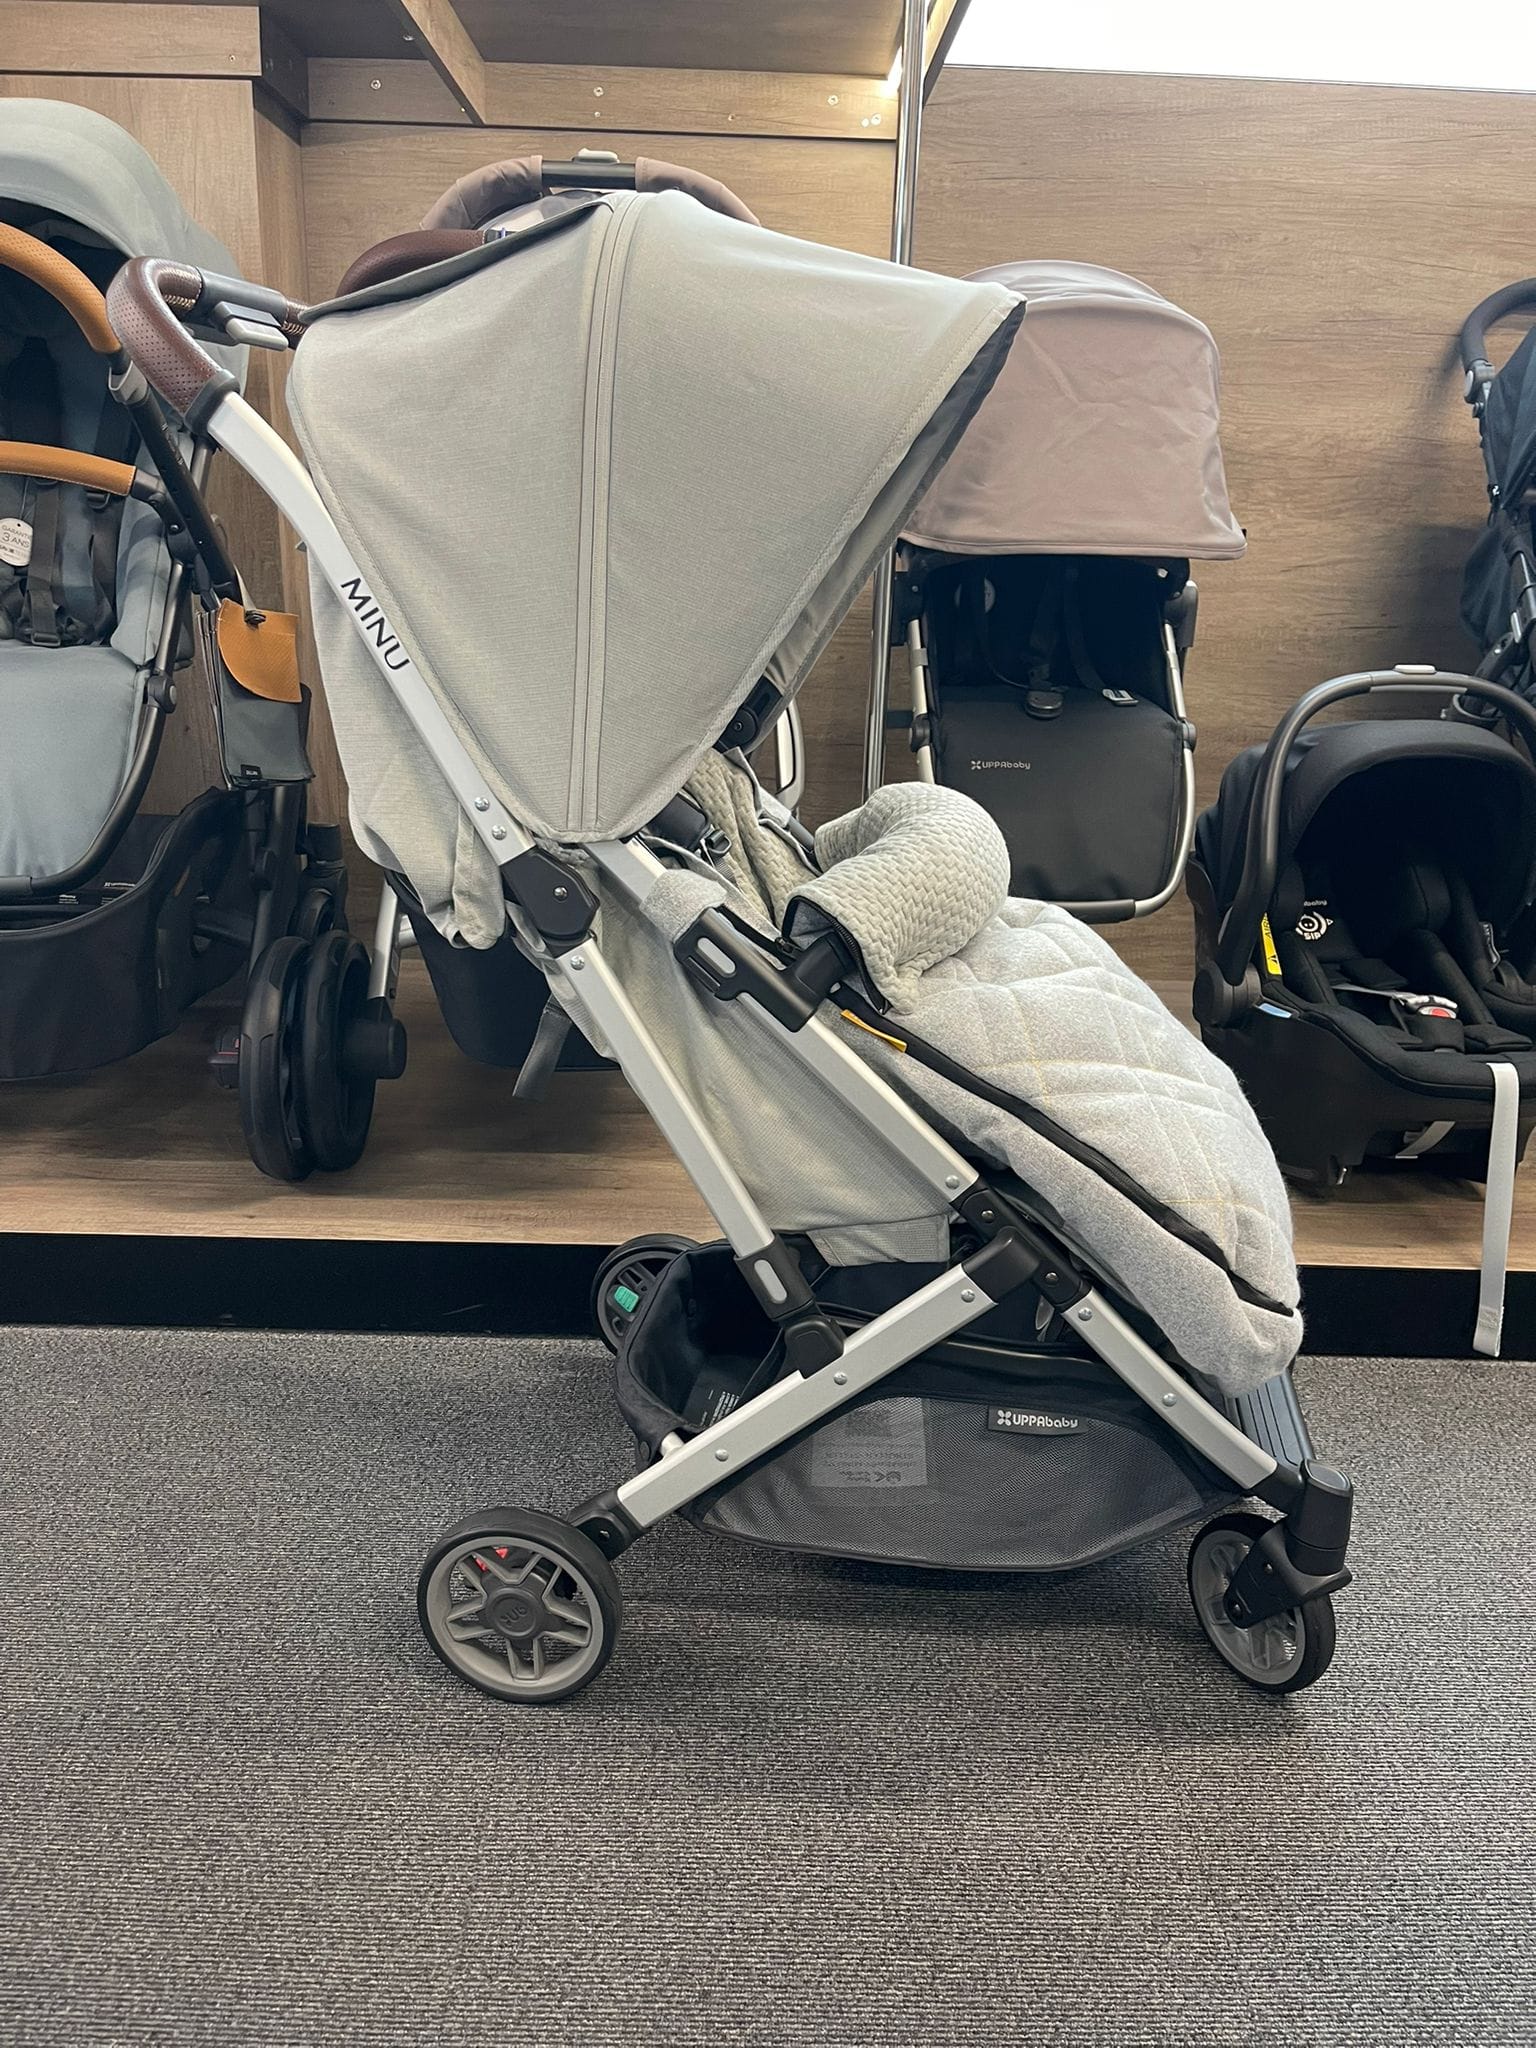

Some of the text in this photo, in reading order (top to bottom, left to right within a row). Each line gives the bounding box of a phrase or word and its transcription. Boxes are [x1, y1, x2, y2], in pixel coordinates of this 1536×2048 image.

[2, 532, 30, 548] 3 ANS
[340, 577, 410, 670] MINU
[981, 761, 1031, 770] UPPAbaby
[1012, 1413, 1079, 1429] UPPAbaby
